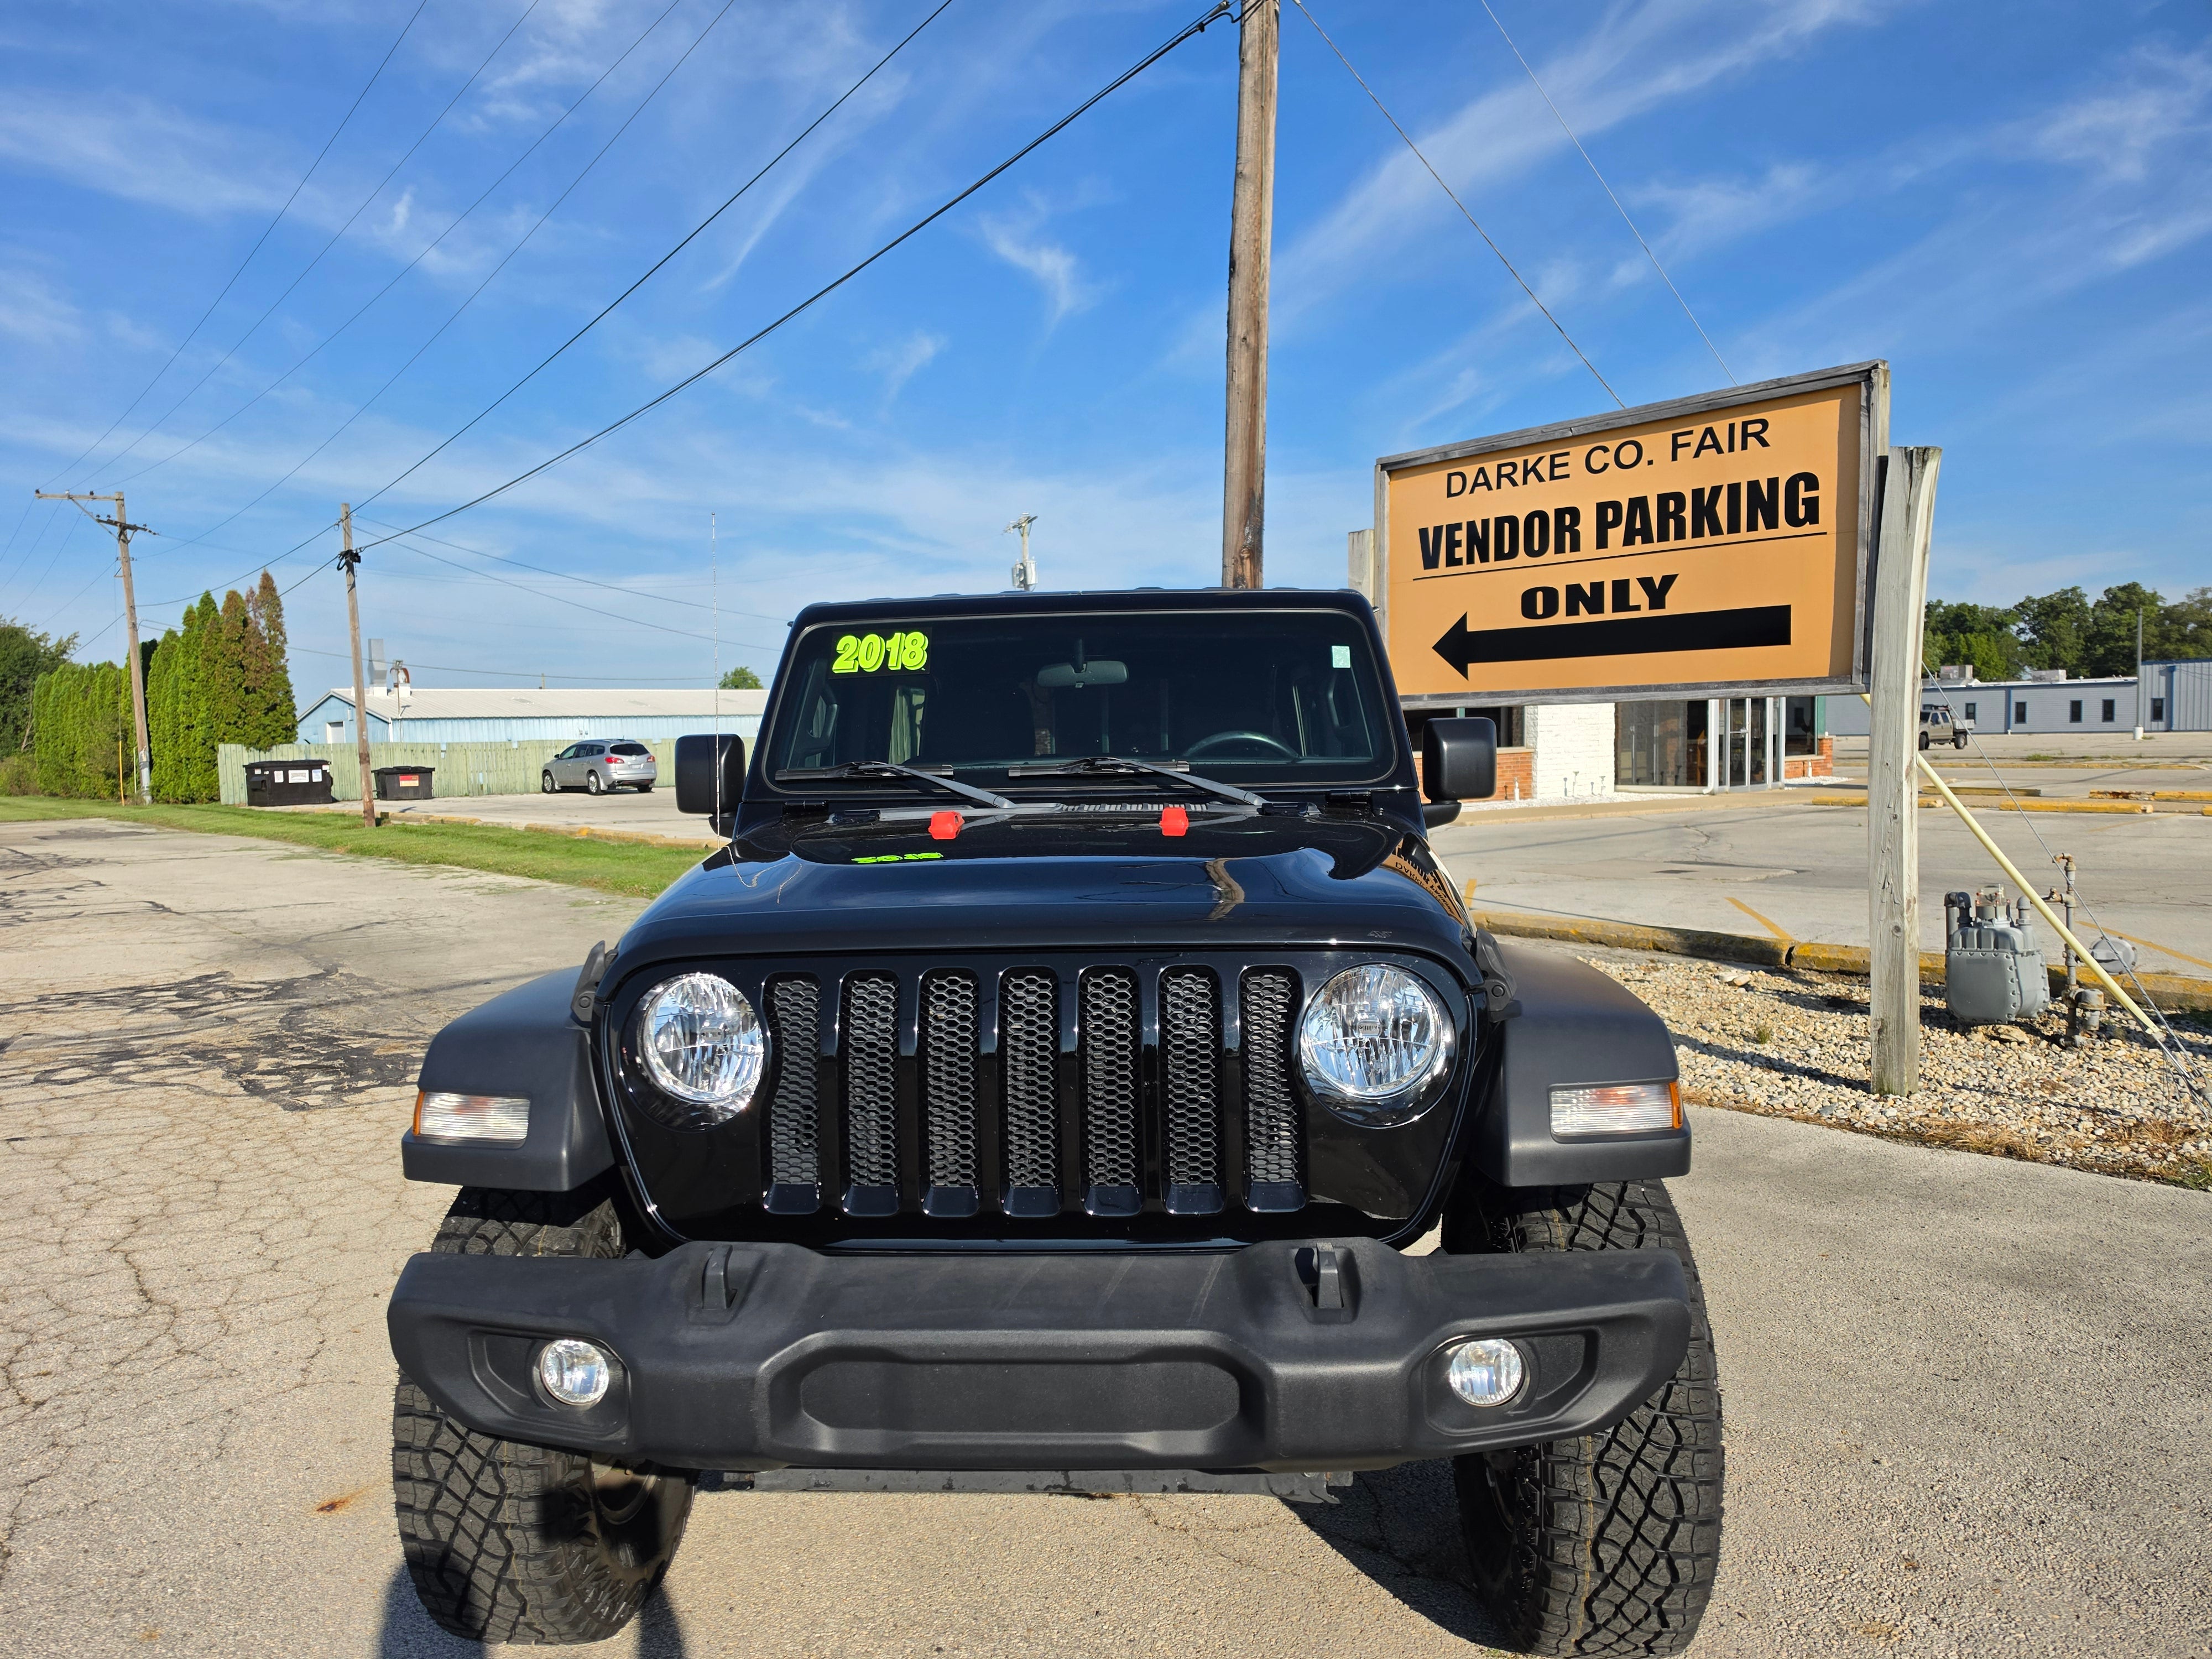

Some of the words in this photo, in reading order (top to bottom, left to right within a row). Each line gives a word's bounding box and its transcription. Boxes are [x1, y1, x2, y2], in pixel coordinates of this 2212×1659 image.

[1447, 451, 1571, 498] DARKE
[1585, 440, 1653, 474] CO.
[1671, 418, 1771, 462] FAIR
[1418, 506, 1581, 571] VENDOR
[1595, 472, 1819, 550] PARKING
[1521, 573, 1679, 620] ONLY
[832, 632, 928, 674] 2018
